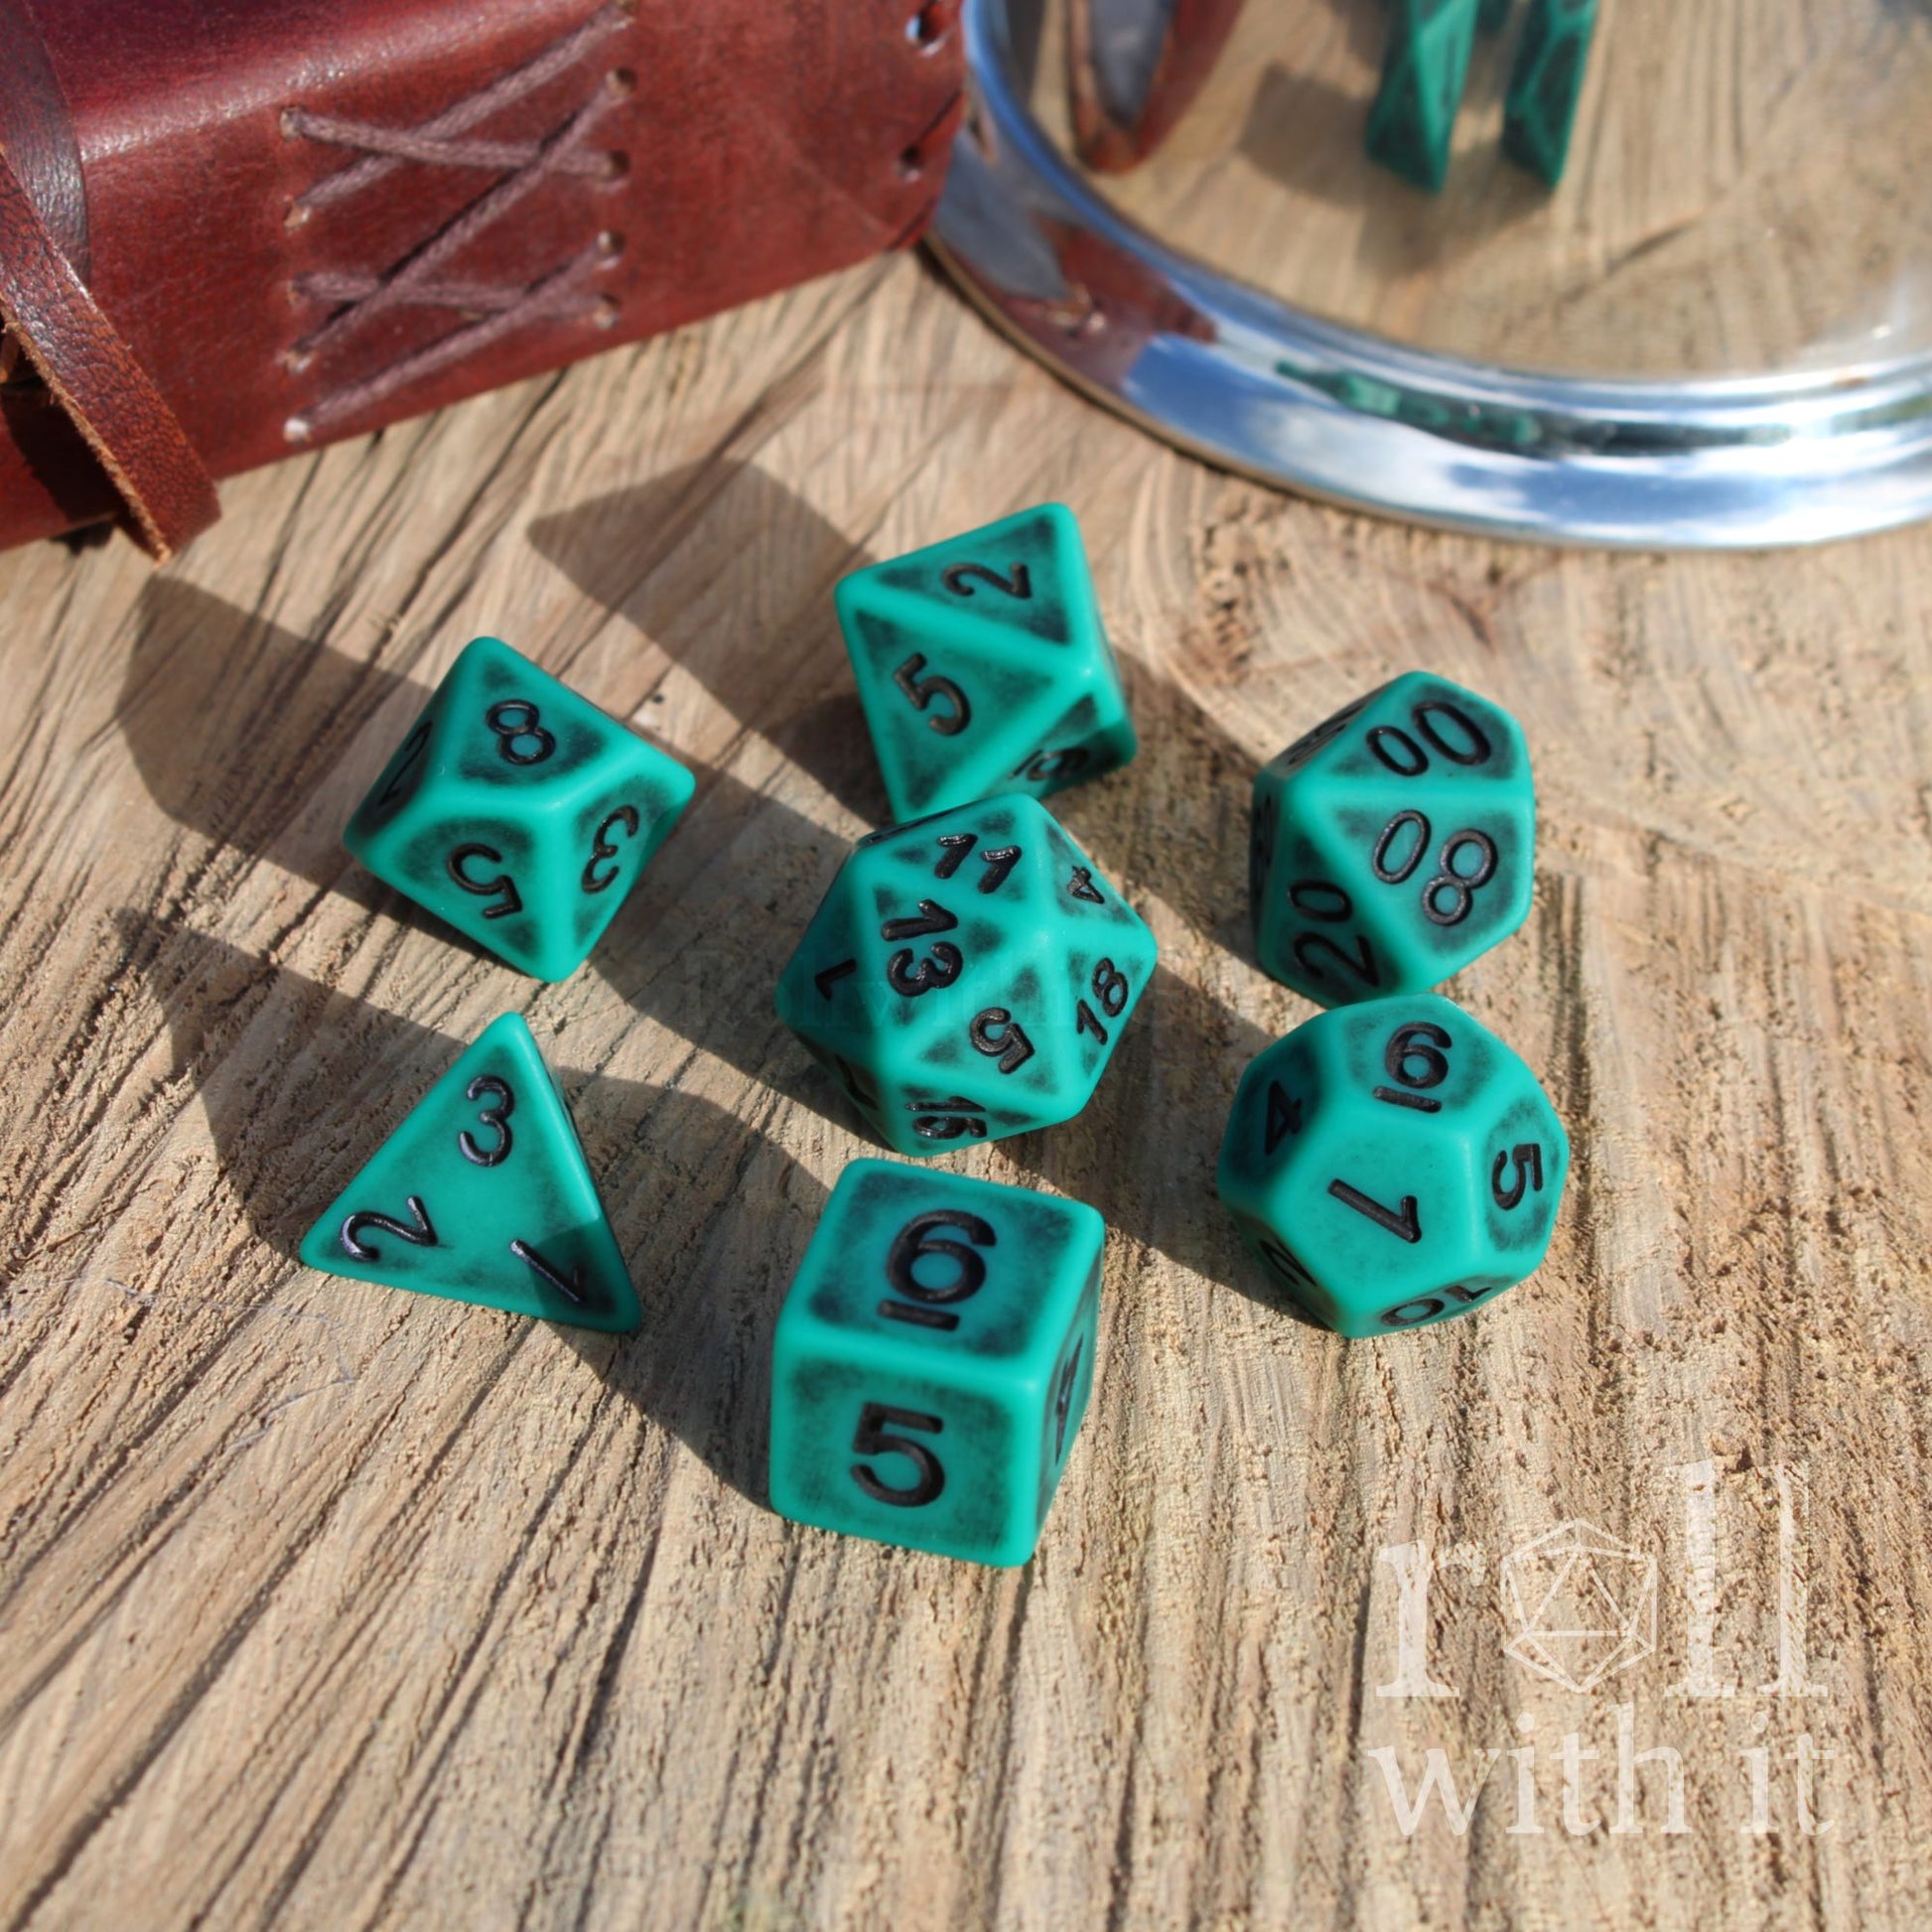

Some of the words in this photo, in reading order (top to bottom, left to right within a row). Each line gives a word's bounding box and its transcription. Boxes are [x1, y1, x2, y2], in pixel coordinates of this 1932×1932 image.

[944, 562, 1033, 600] 2
[484, 699, 556, 765] 8
[894, 652, 972, 736] 5
[1365, 701, 1491, 776] 00
[447, 843, 522, 919] 5
[581, 805, 638, 894] 3
[933, 834, 1023, 894] 11
[1067, 865, 1105, 904] 4
[882, 898, 963, 997] 13
[1288, 880, 1380, 987] 20
[1076, 958, 1128, 1045] 18
[970, 1008, 1035, 1074] 5
[1372, 1021, 1453, 1113] 6
[459, 1074, 514, 1168] 3
[1264, 1080, 1304, 1156] 4
[1327, 1178, 1423, 1244] 1
[1492, 1144, 1544, 1210] 5
[340, 1195, 439, 1262] 2
[510, 1239, 588, 1306] 1
[878, 1208, 998, 1331] 6
[850, 1401, 946, 1508] 5
